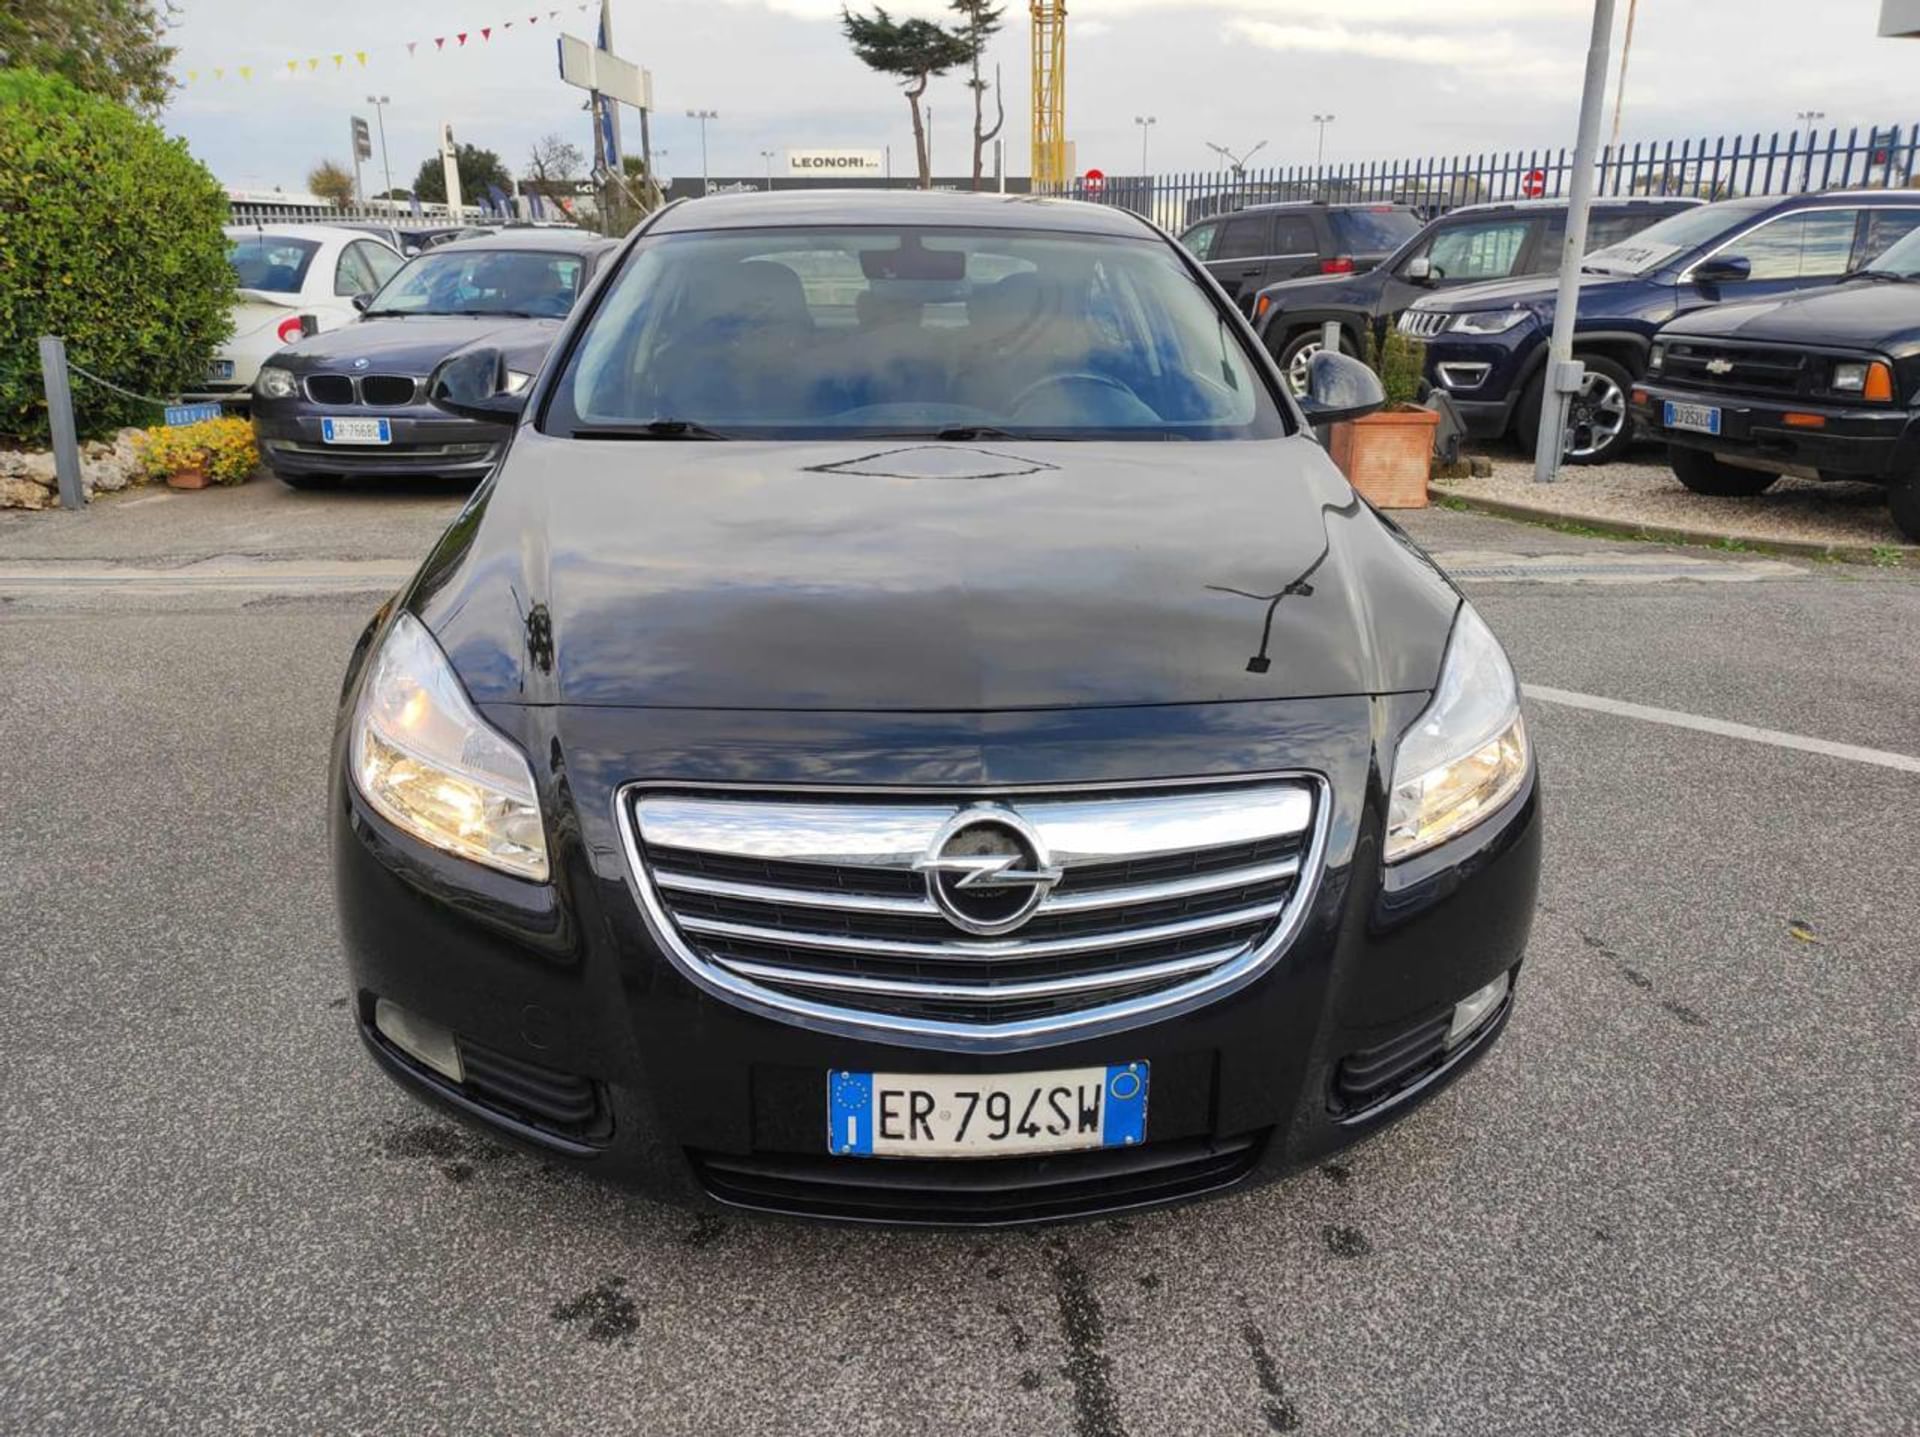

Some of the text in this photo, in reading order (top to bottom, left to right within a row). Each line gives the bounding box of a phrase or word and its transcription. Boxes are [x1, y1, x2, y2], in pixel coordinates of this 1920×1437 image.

[791, 156, 864, 169] LEONORI
[879, 1089, 936, 1141] ER
[954, 1084, 1102, 1142] 794SW
